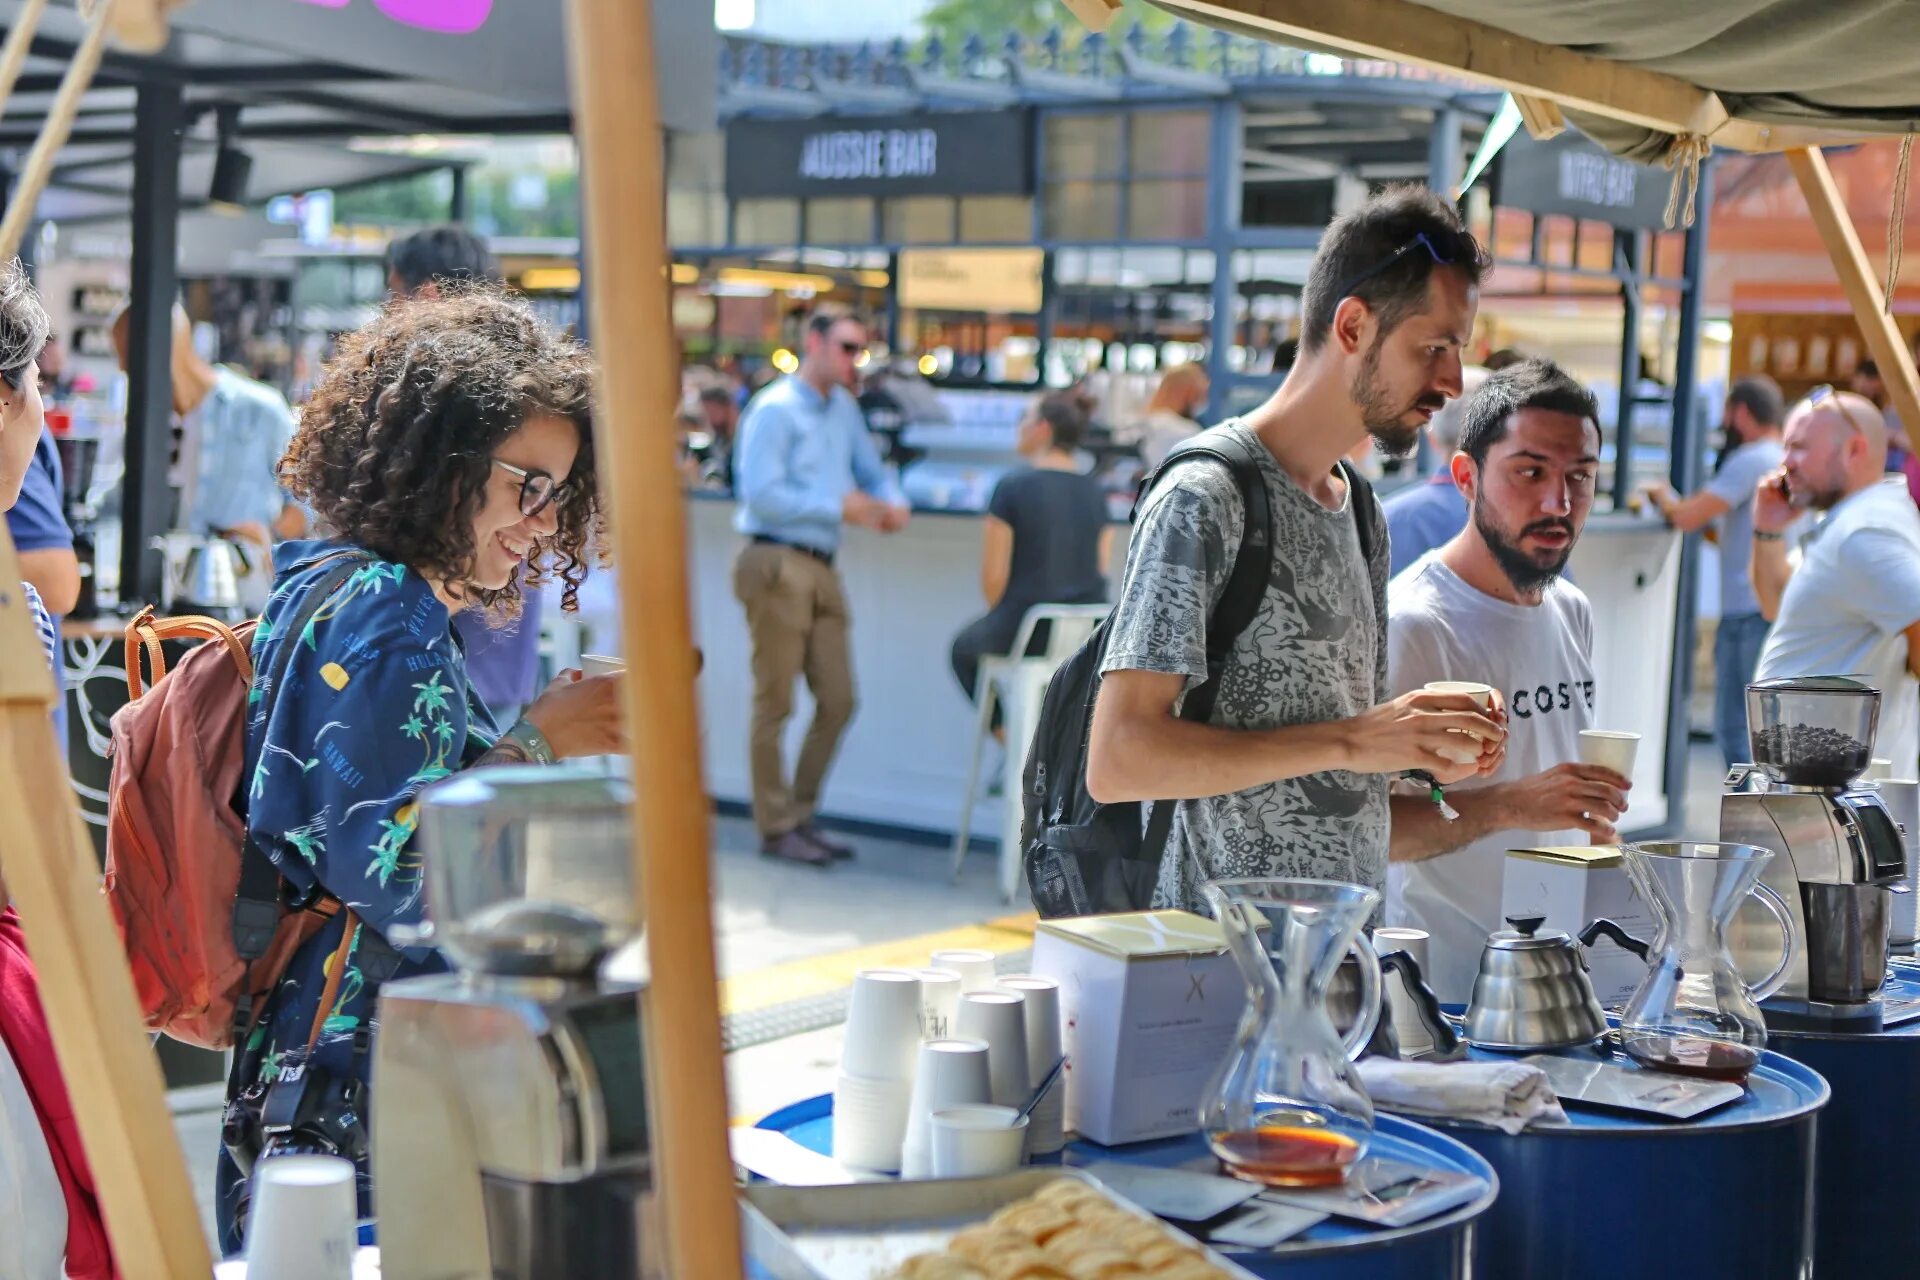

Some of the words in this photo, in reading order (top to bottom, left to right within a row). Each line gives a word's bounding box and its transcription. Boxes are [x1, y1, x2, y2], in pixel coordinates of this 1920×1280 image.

[800, 131, 882, 179] AUSSIE
[887, 128, 937, 178] BAR
[1605, 158, 1636, 208] BAR
[408, 592, 437, 637] WAVES
[405, 650, 447, 672] HULA
[323, 740, 365, 789] HAWAII
